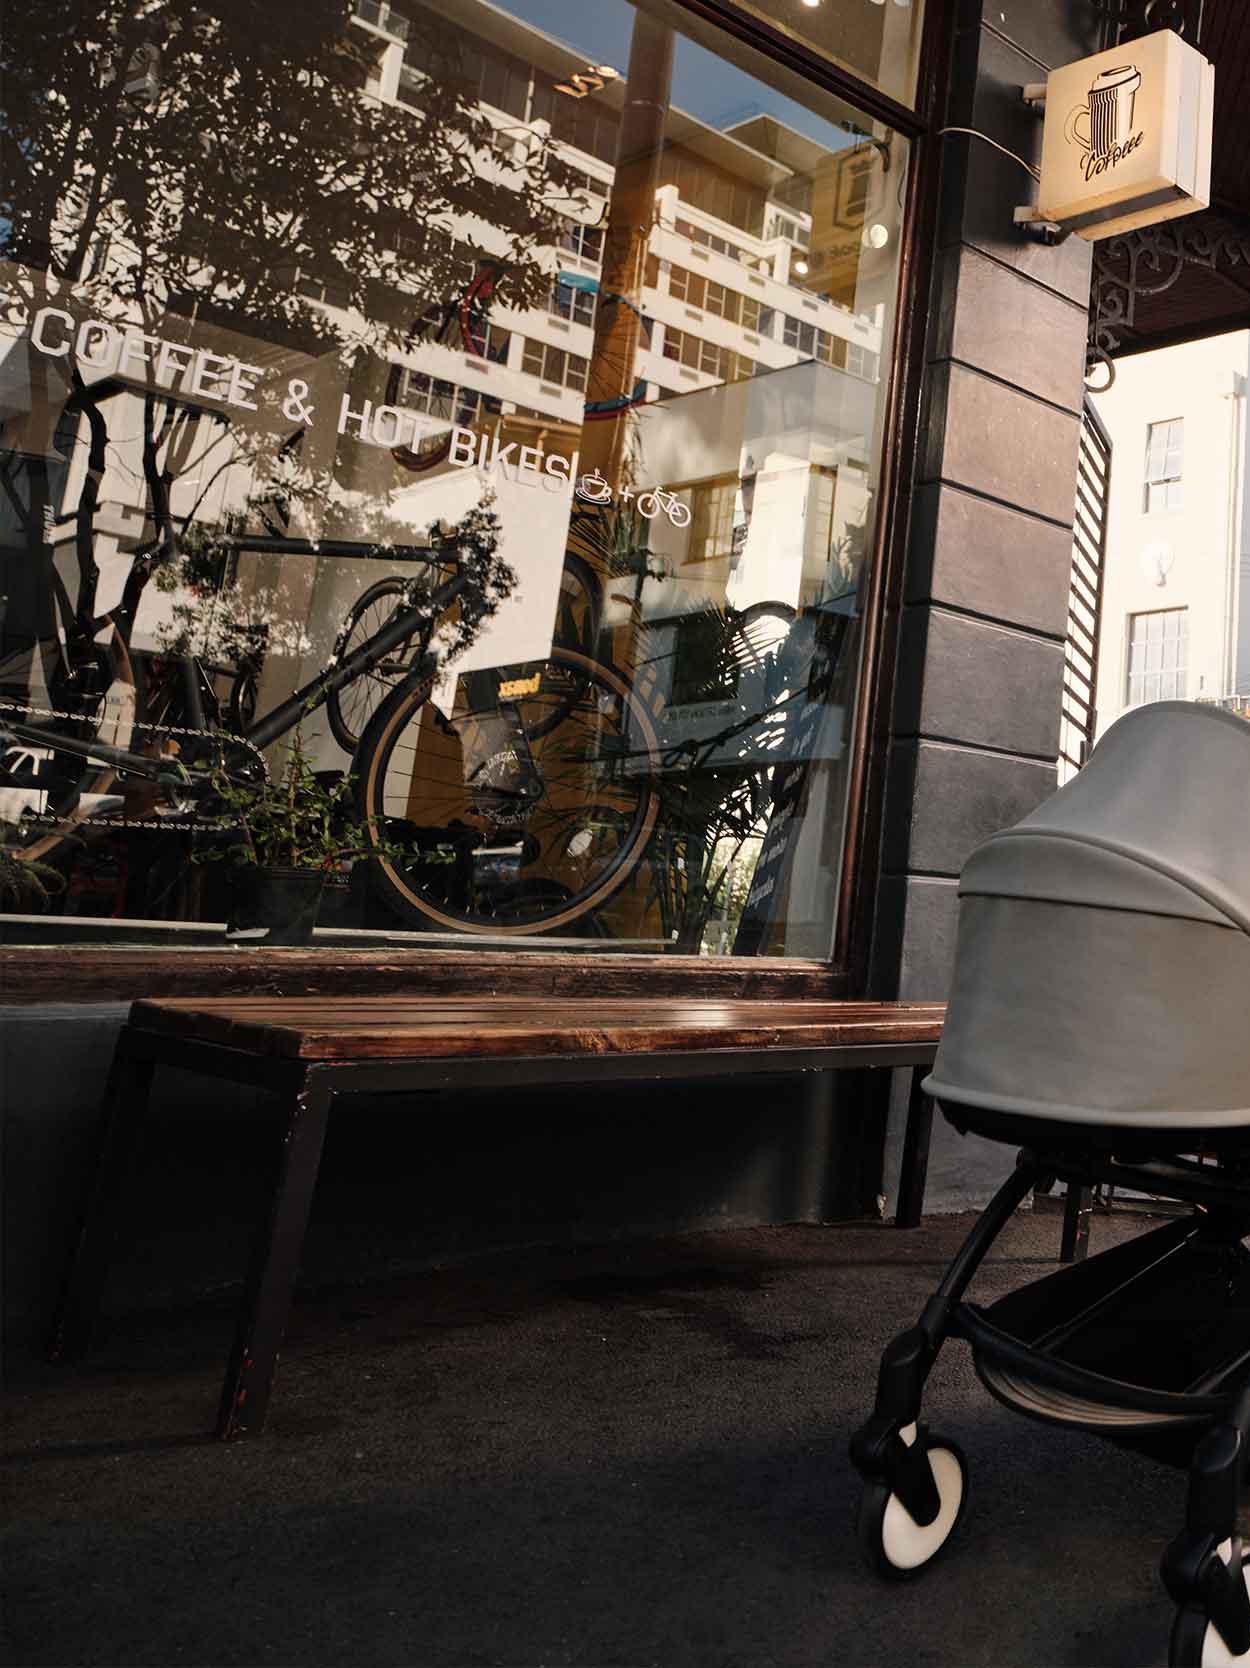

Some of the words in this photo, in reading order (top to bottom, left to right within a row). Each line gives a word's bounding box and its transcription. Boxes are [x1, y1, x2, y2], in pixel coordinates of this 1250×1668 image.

[31, 307, 265, 411] COFFEE
[282, 378, 315, 426] &
[337, 393, 432, 455] HOT
